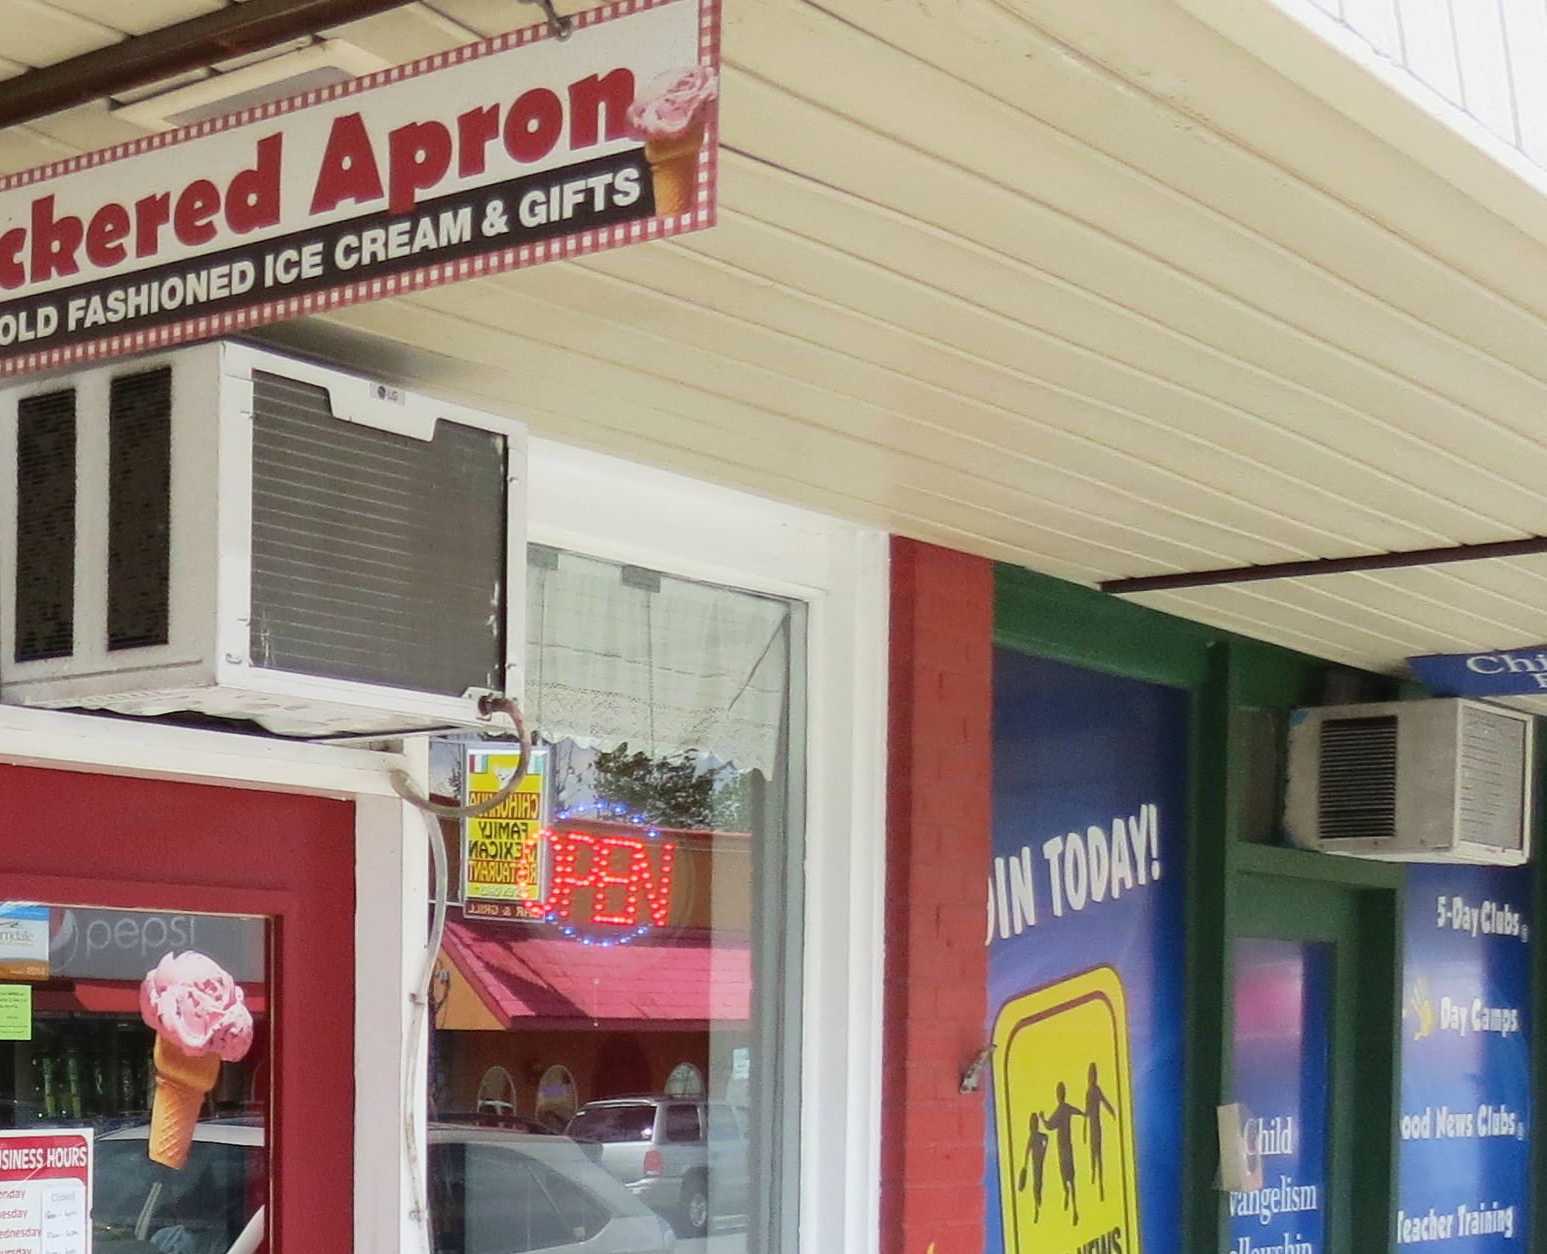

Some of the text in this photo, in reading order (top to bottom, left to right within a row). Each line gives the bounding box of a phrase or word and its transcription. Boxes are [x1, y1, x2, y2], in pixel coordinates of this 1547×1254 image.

[309, 67, 635, 213] Apron
[68, 261, 254, 332] FASHIONED
[264, 242, 324, 288] ICE
[333, 207, 473, 272] CREAM
[481, 199, 510, 238] &
[519, 167, 641, 229] GIFTS
[518, 827, 676, 927] OPEN
[1042, 803, 1161, 918] TODAY!
[86, 915, 196, 960] pepsi
[1436, 895, 1479, 938] 5-Day
[1439, 996, 1519, 1037] Day Camps
[1243, 1115, 1294, 1157] Child
[1400, 1106, 1431, 1140] ood
[1436, 1106, 1474, 1140] News
[47, 1146, 87, 1168] HOURS
[1457, 1202, 1514, 1239] Training
